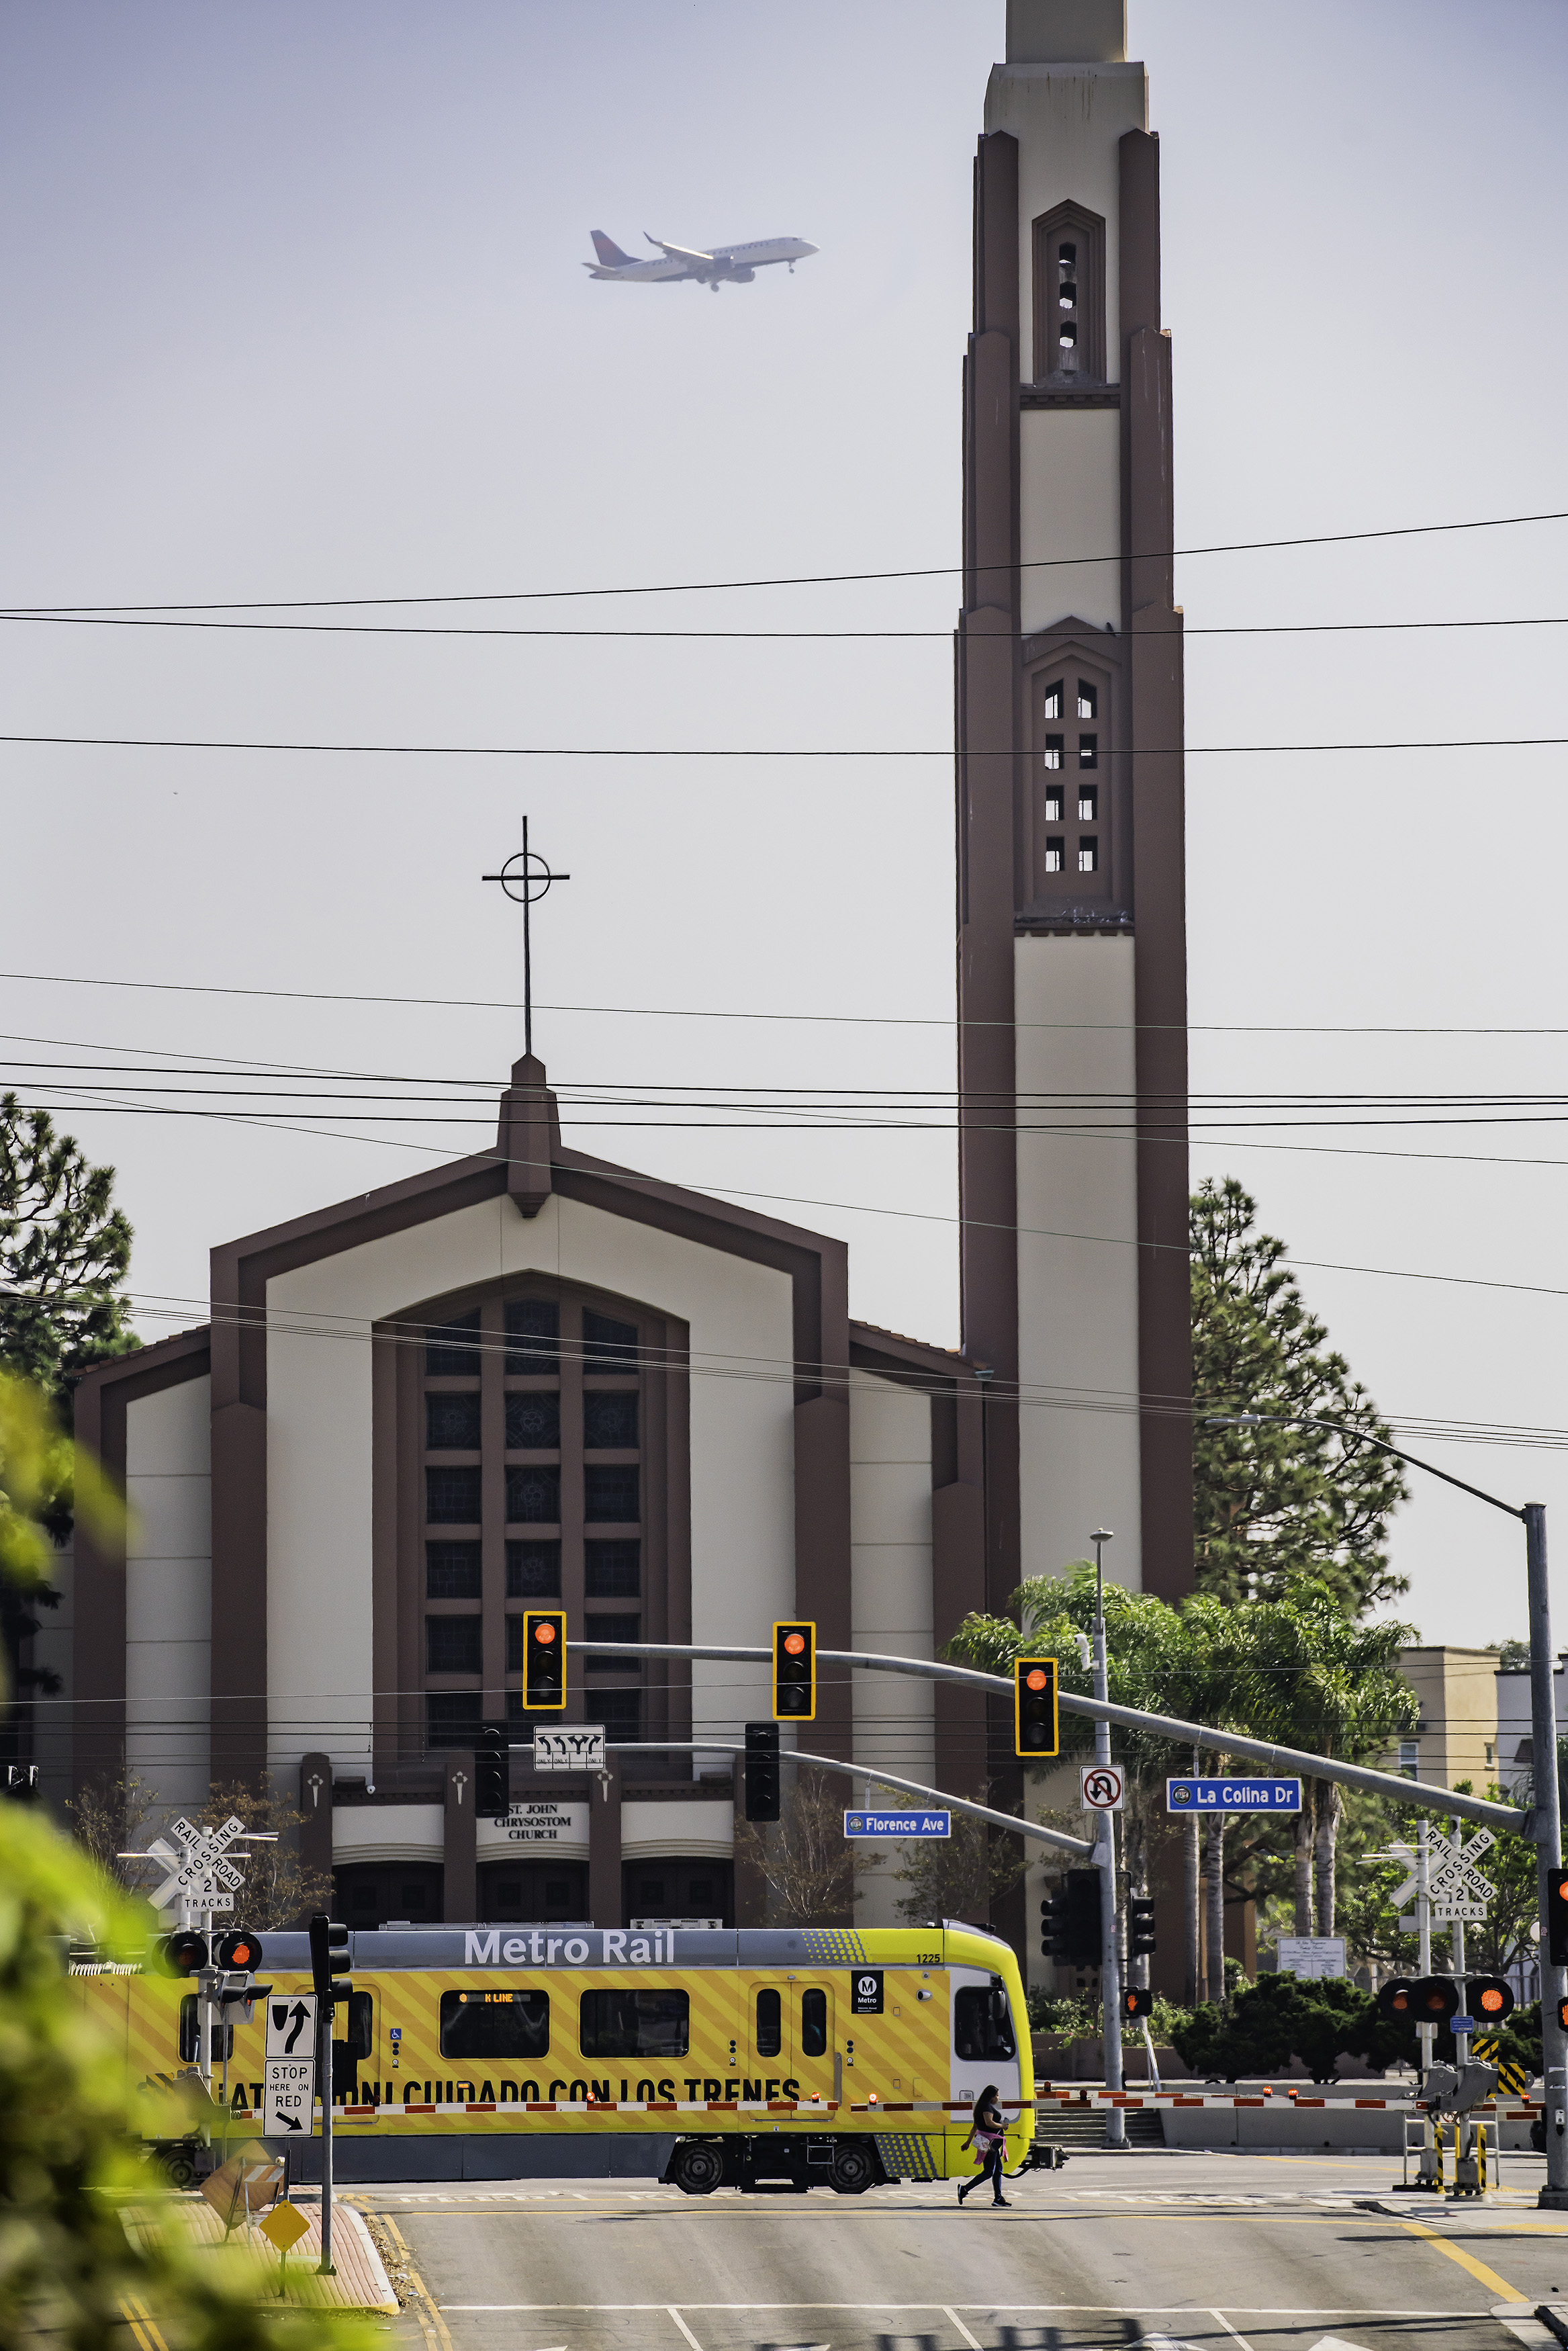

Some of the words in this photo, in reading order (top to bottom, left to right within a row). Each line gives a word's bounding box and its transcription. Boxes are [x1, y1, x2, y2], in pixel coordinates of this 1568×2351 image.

[1197, 1786, 1217, 1804] La
[1222, 1786, 1269, 1804] Colina
[1275, 1786, 1293, 1804] Dr
[508, 1804, 522, 1814] ST.
[526, 1804, 557, 1814] JOHN
[494, 1816, 571, 1828] CHRYSOSTOM
[866, 1817, 917, 1832] Florence
[921, 1817, 944, 1831] Ave
[508, 1829, 557, 1840] CHURCH
[174, 1821, 201, 1850] RAIL
[212, 1857, 241, 1887] ROAD
[177, 1822, 238, 1886] CROSSING
[1425, 1830, 1452, 1860] RAIL
[1463, 1868, 1493, 1898] ROAD
[1429, 1833, 1490, 1895] CROSSING
[203, 1879, 212, 1892] 2
[1456, 1888, 1465, 1901] 2
[185, 1898, 231, 1908] TRACKS
[1437, 1907, 1484, 1916] TRACKS
[465, 1931, 590, 1965] Metro
[602, 1930, 674, 1963] Rail
[916, 1953, 940, 1963] 1225
[862, 1980, 874, 1992] M
[485, 1993, 491, 2002] K
[493, 1993, 513, 2002] LINE
[271, 2067, 308, 2079] STOP
[269, 2083, 290, 2091] HERE
[297, 2083, 309, 2091] ON
[404, 2080, 539, 2104] CUIDADO
[549, 2079, 610, 2102] CON
[684, 2078, 800, 2102] TRENES
[275, 2095, 302, 2107] RED
